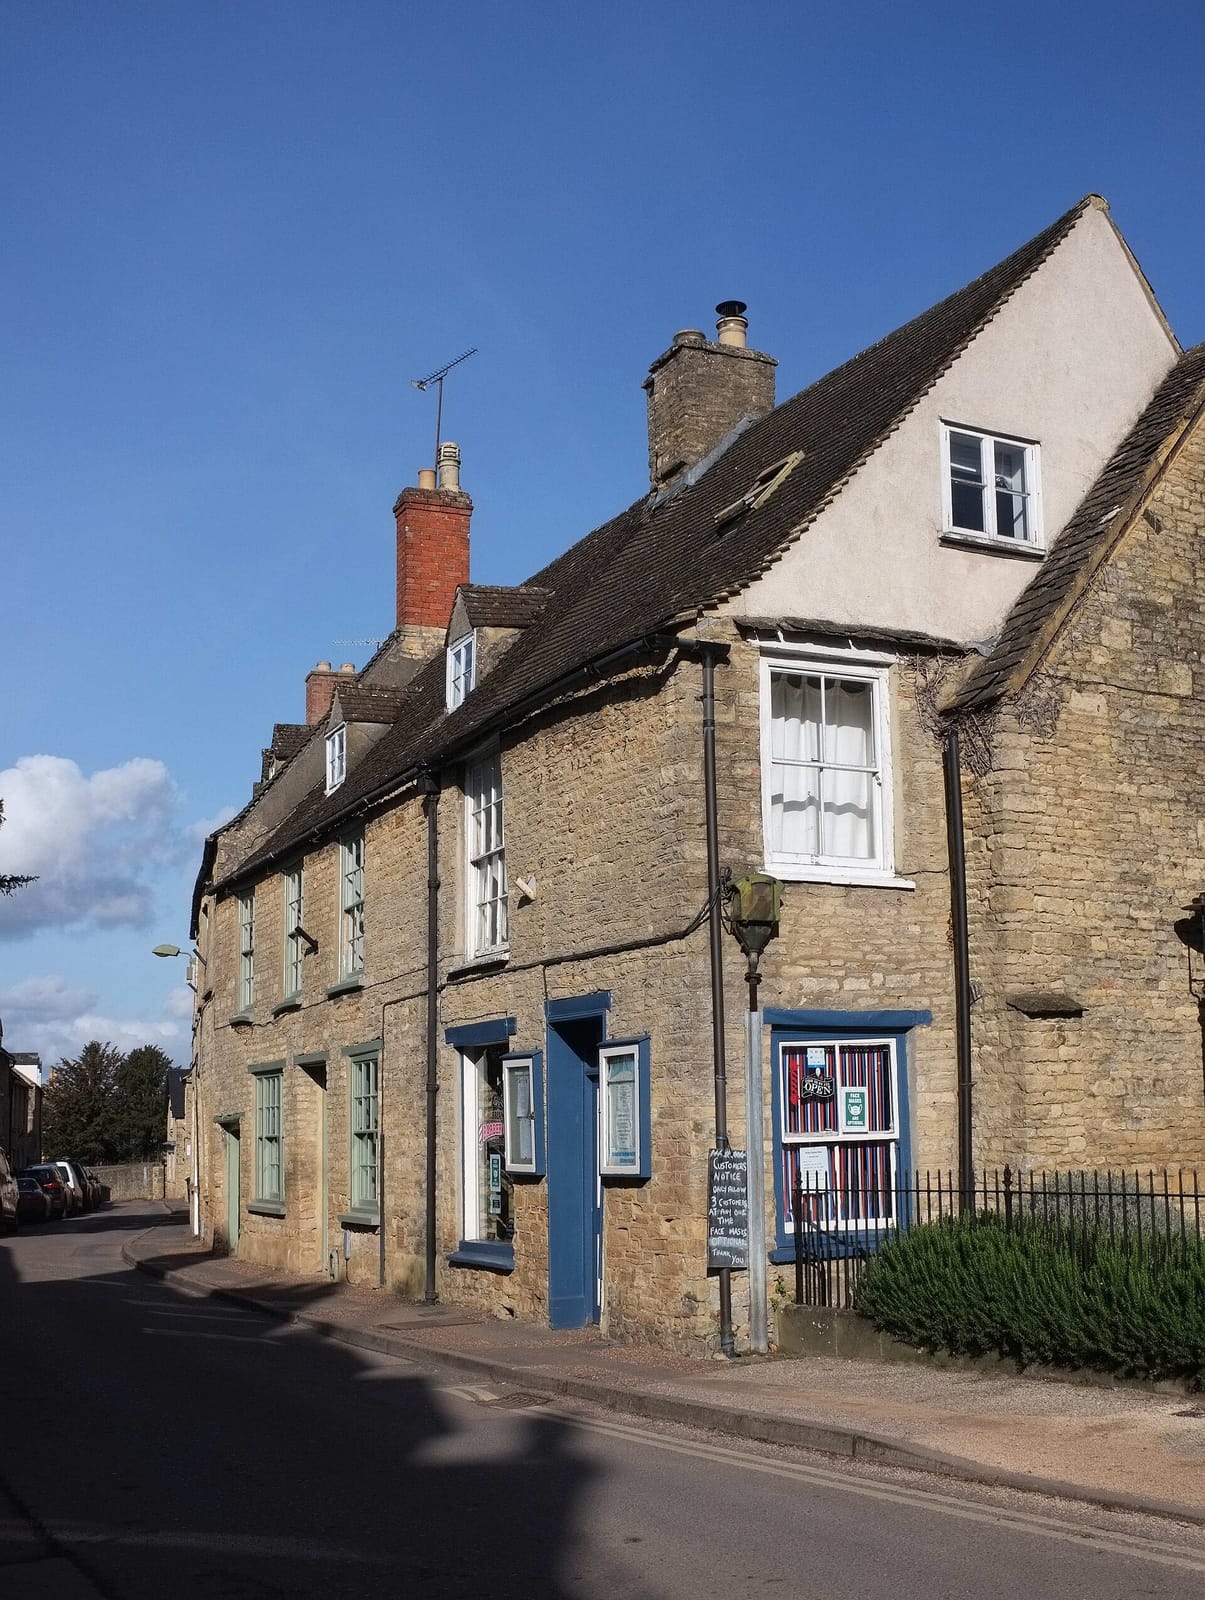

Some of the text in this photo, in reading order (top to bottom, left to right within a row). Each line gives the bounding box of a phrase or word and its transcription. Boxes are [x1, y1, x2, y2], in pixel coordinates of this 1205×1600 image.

[804, 1082, 832, 1095] OPEN
[713, 1171, 741, 1182] NOTICE
[711, 1196, 717, 1207] 3
[708, 1207, 718, 1216] AT
[717, 1216, 734, 1225] TIME
[710, 1226, 747, 1237] FACE MASKS
[731, 1255, 744, 1265] YOU
